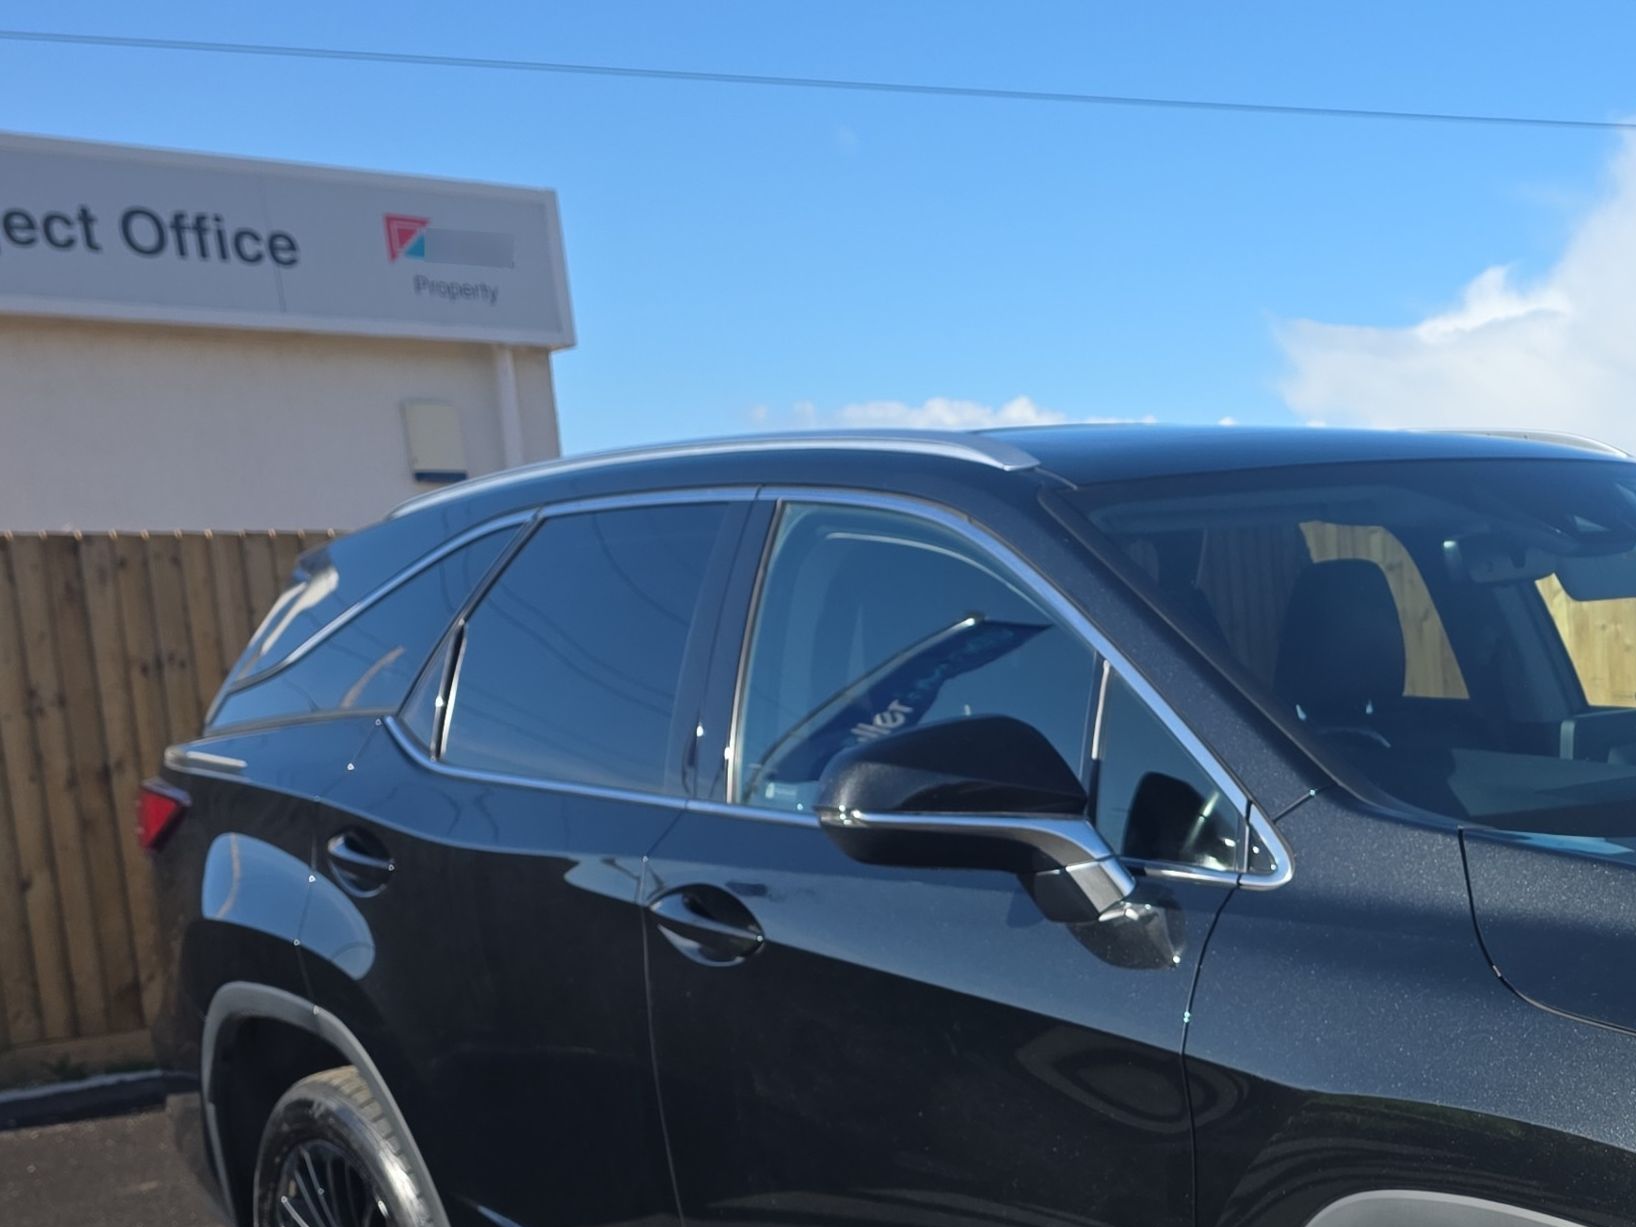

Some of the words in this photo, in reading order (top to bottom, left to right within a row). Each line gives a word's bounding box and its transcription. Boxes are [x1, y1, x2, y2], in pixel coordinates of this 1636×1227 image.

[1, 204, 103, 253] ect
[120, 206, 299, 267] Office
[414, 275, 497, 306] Property
